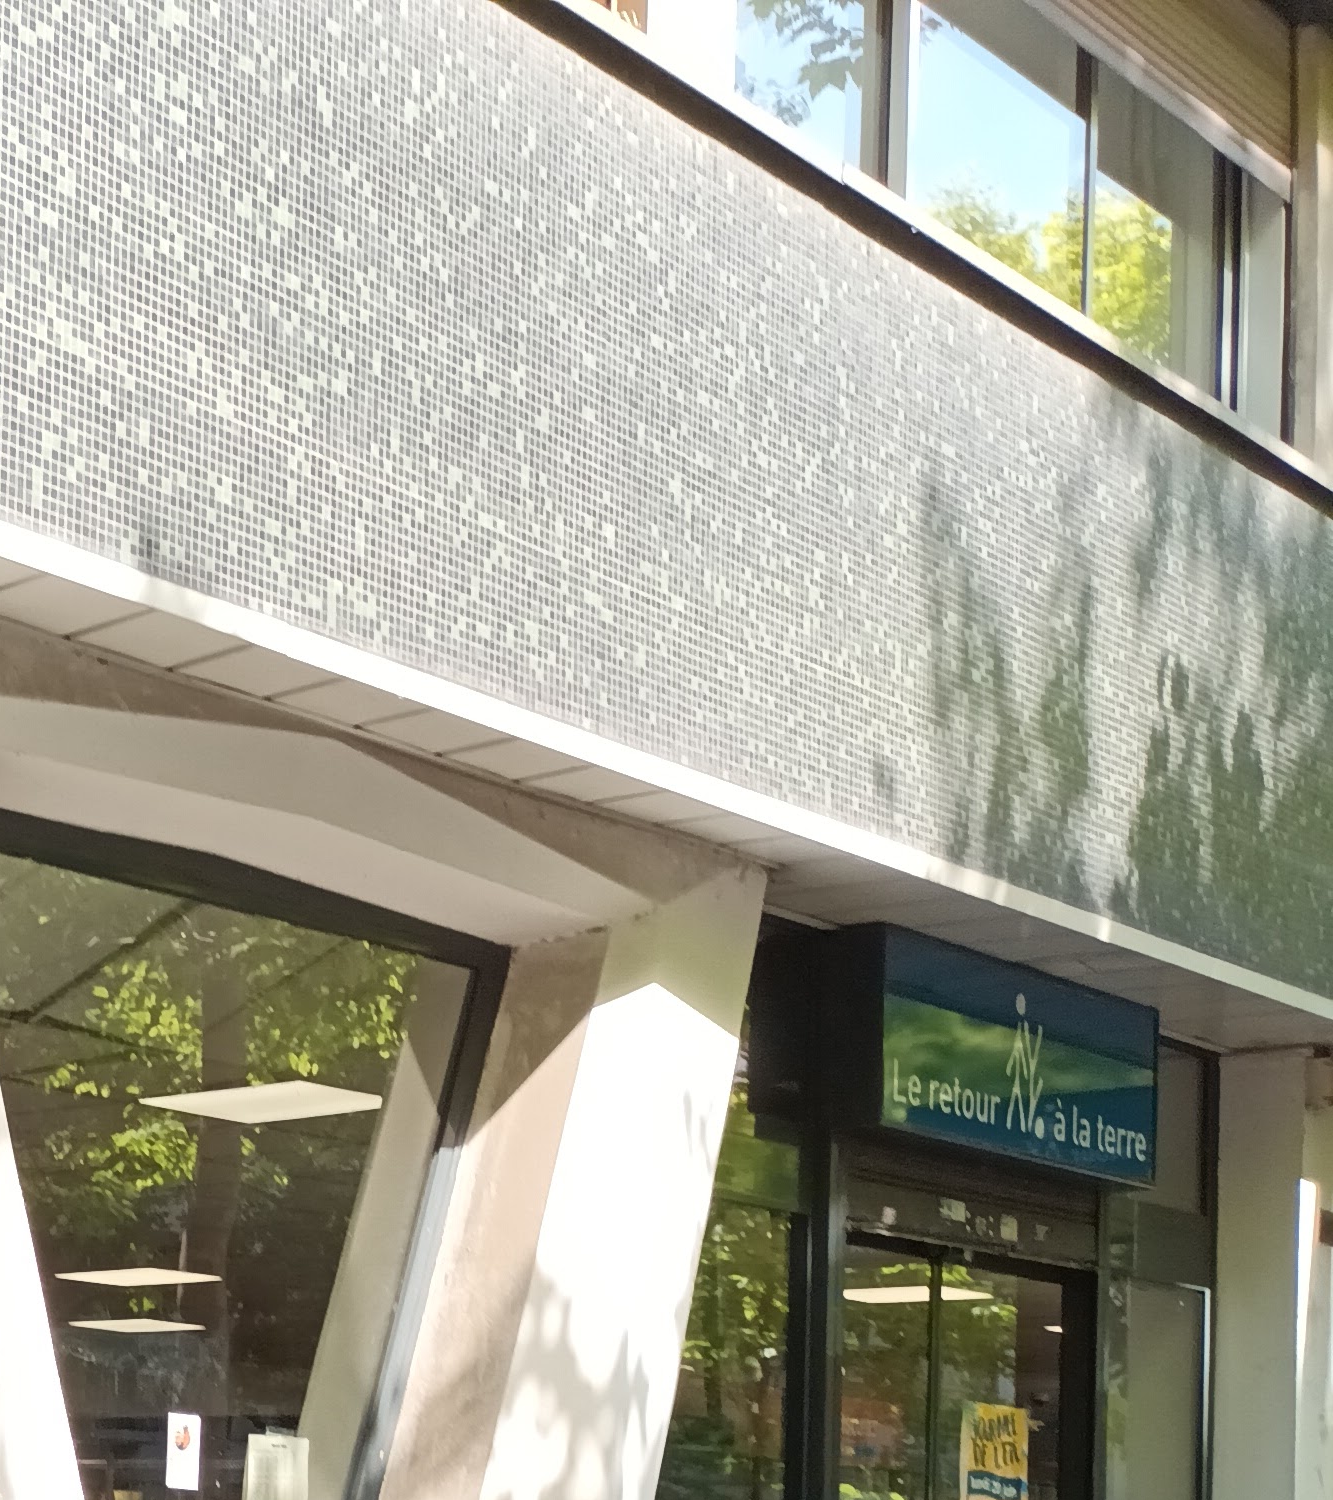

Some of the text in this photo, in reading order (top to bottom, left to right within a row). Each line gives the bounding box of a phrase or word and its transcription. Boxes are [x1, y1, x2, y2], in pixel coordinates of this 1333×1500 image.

[892, 1057, 1148, 1163] Le retour à la terre
